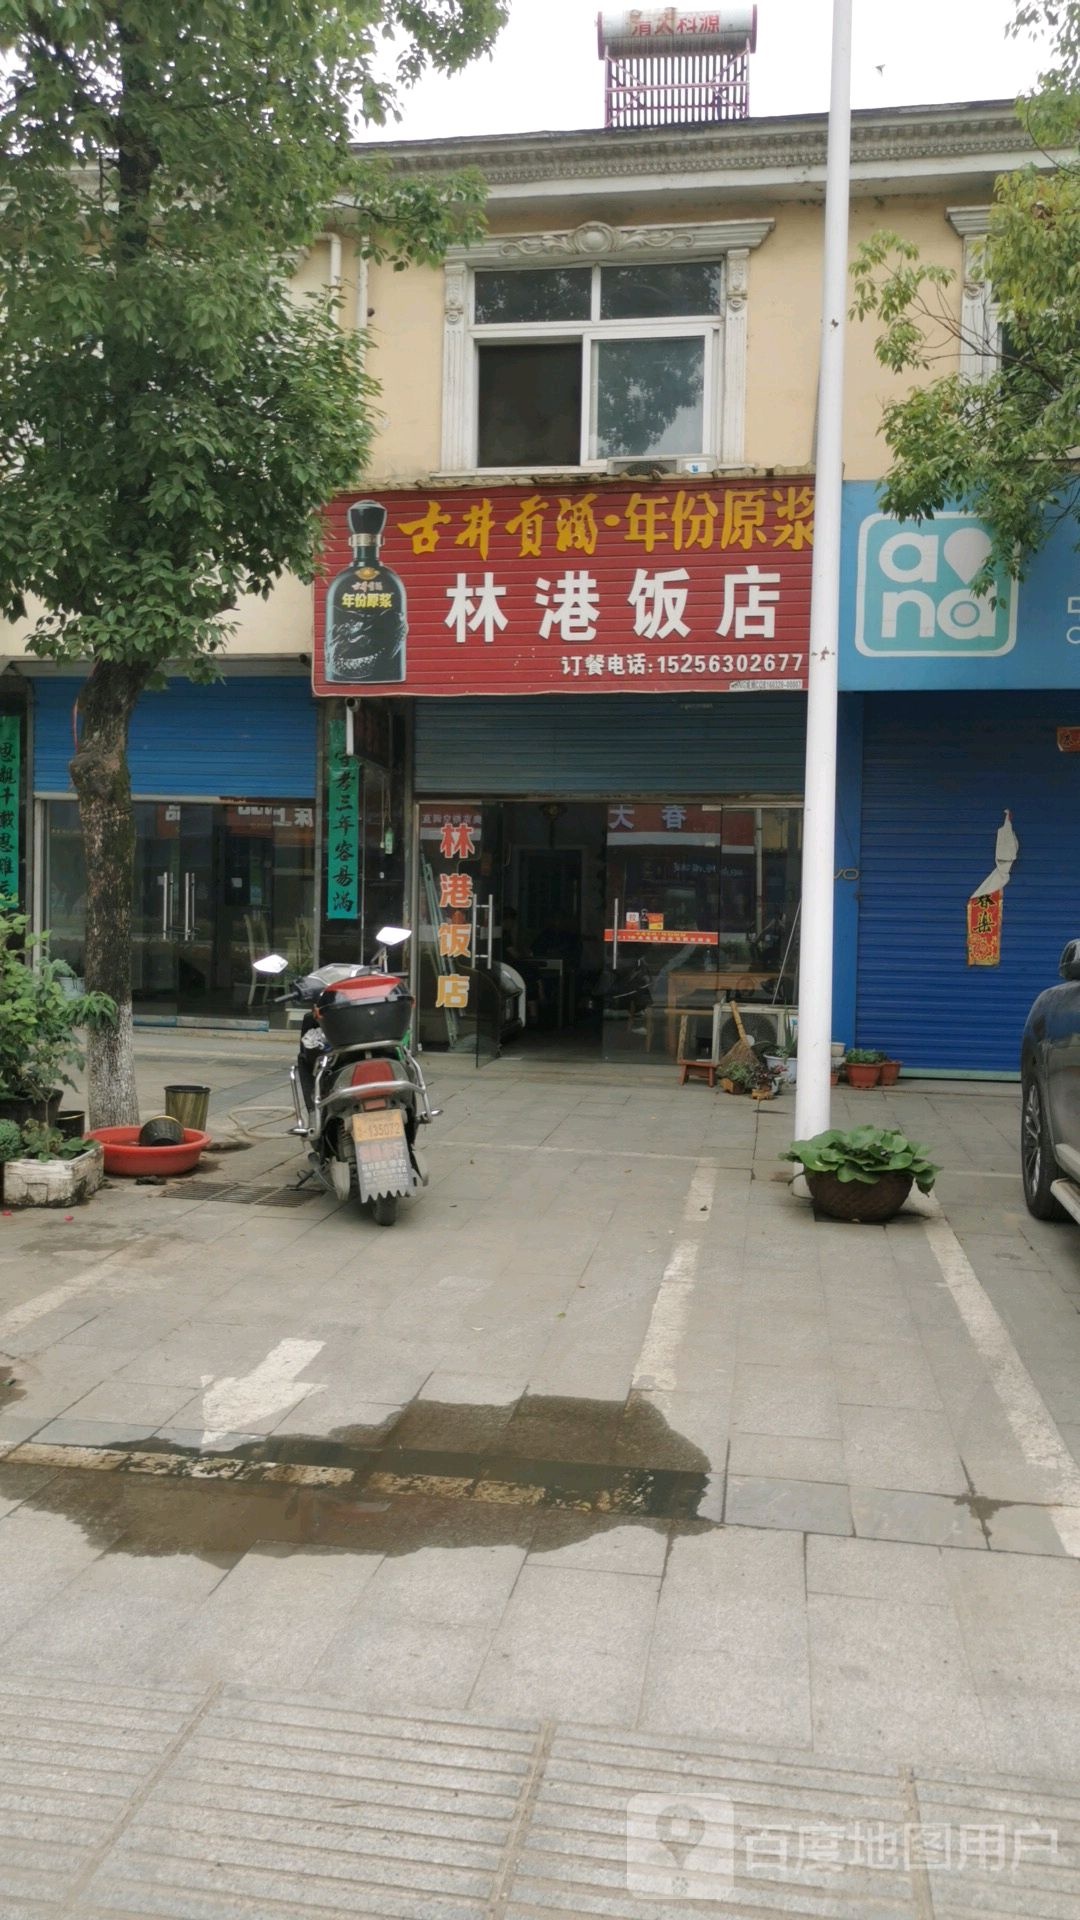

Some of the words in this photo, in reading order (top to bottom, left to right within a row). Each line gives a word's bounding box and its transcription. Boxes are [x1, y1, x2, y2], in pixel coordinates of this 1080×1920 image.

[341, 592, 393, 608] 年份原浆
[445, 565, 781, 643] 林港饭店
[435, 822, 475, 1008] 林港饭店
